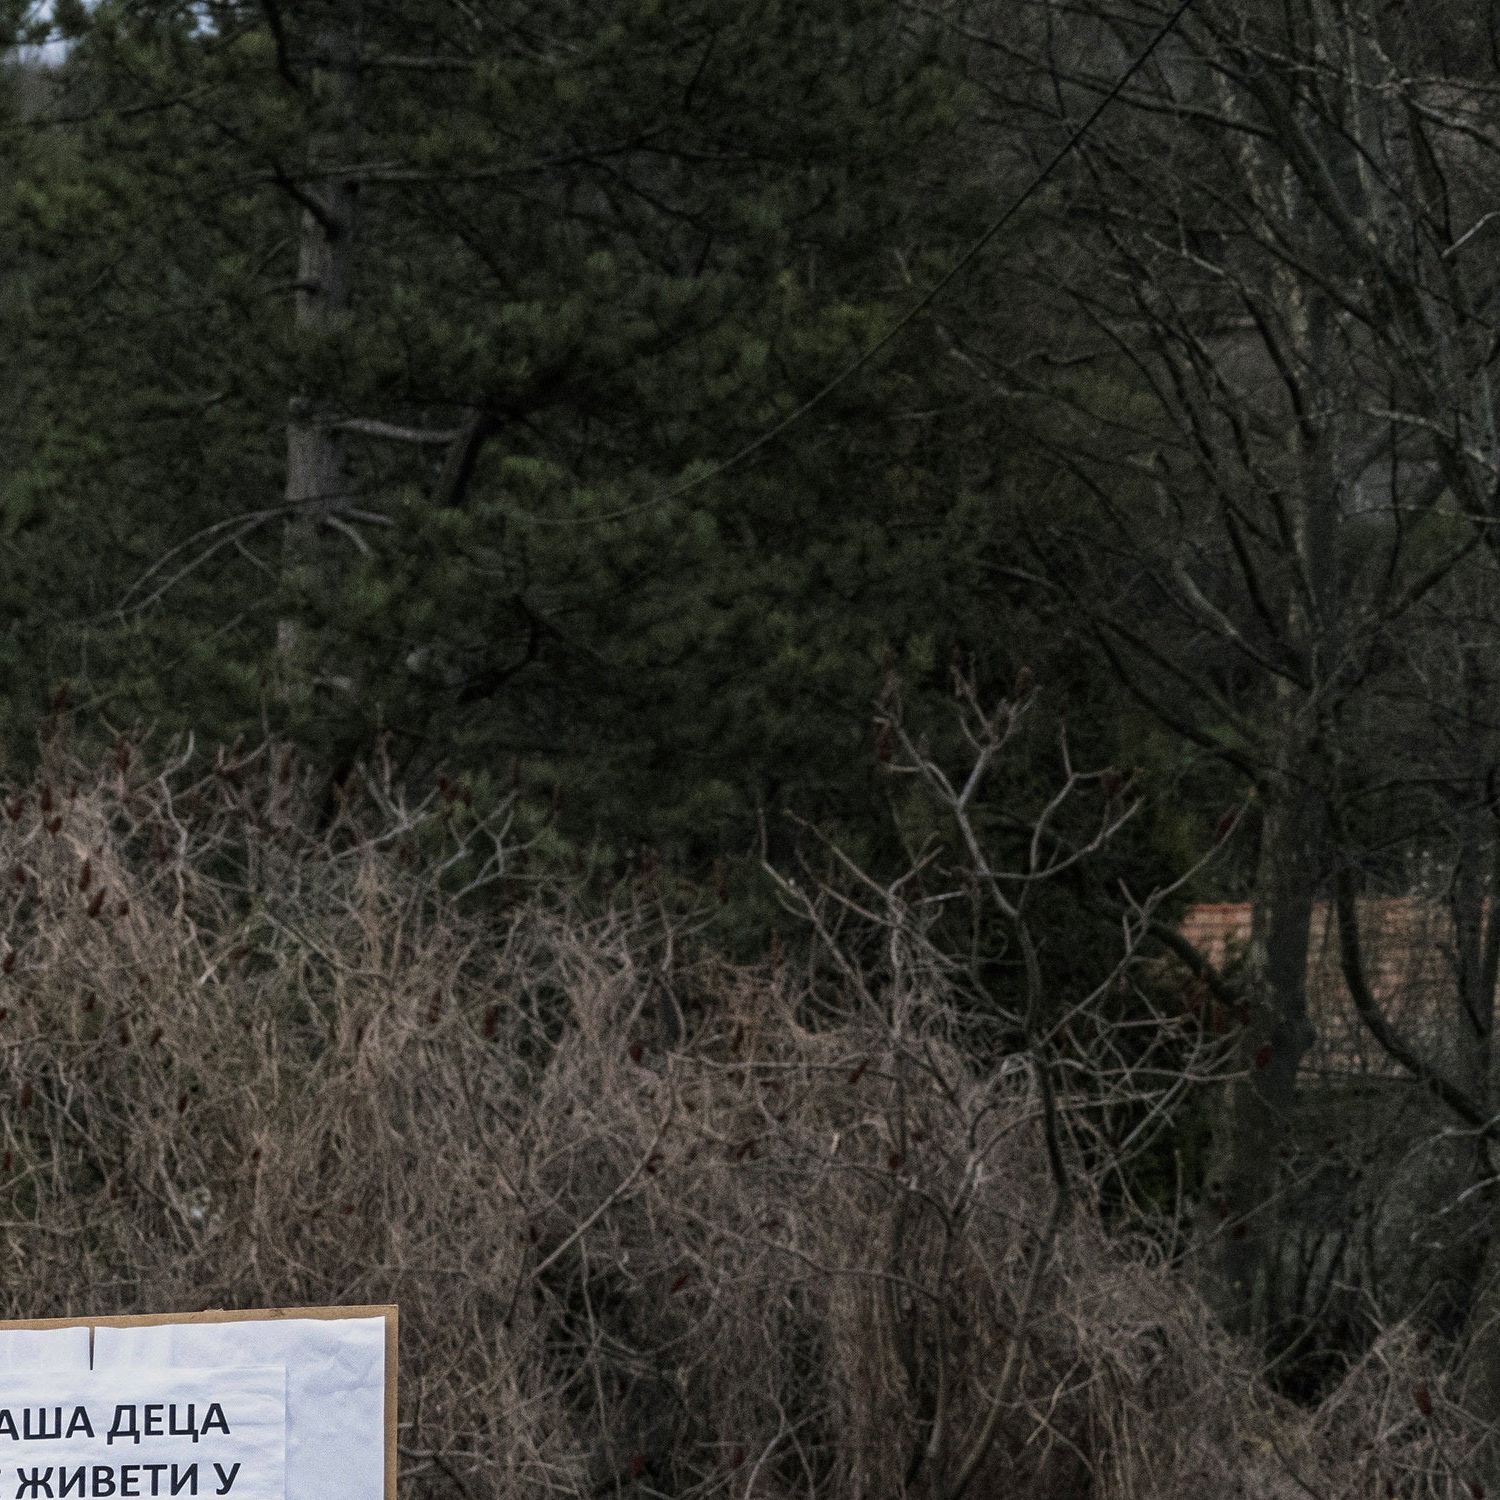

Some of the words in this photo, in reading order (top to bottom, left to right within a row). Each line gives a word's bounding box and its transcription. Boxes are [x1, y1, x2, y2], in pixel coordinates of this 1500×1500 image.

[106, 1402, 231, 1445] ДЕЦА
[15, 1463, 199, 1500] ЖИВЕТИ
[213, 1462, 242, 1496] У
